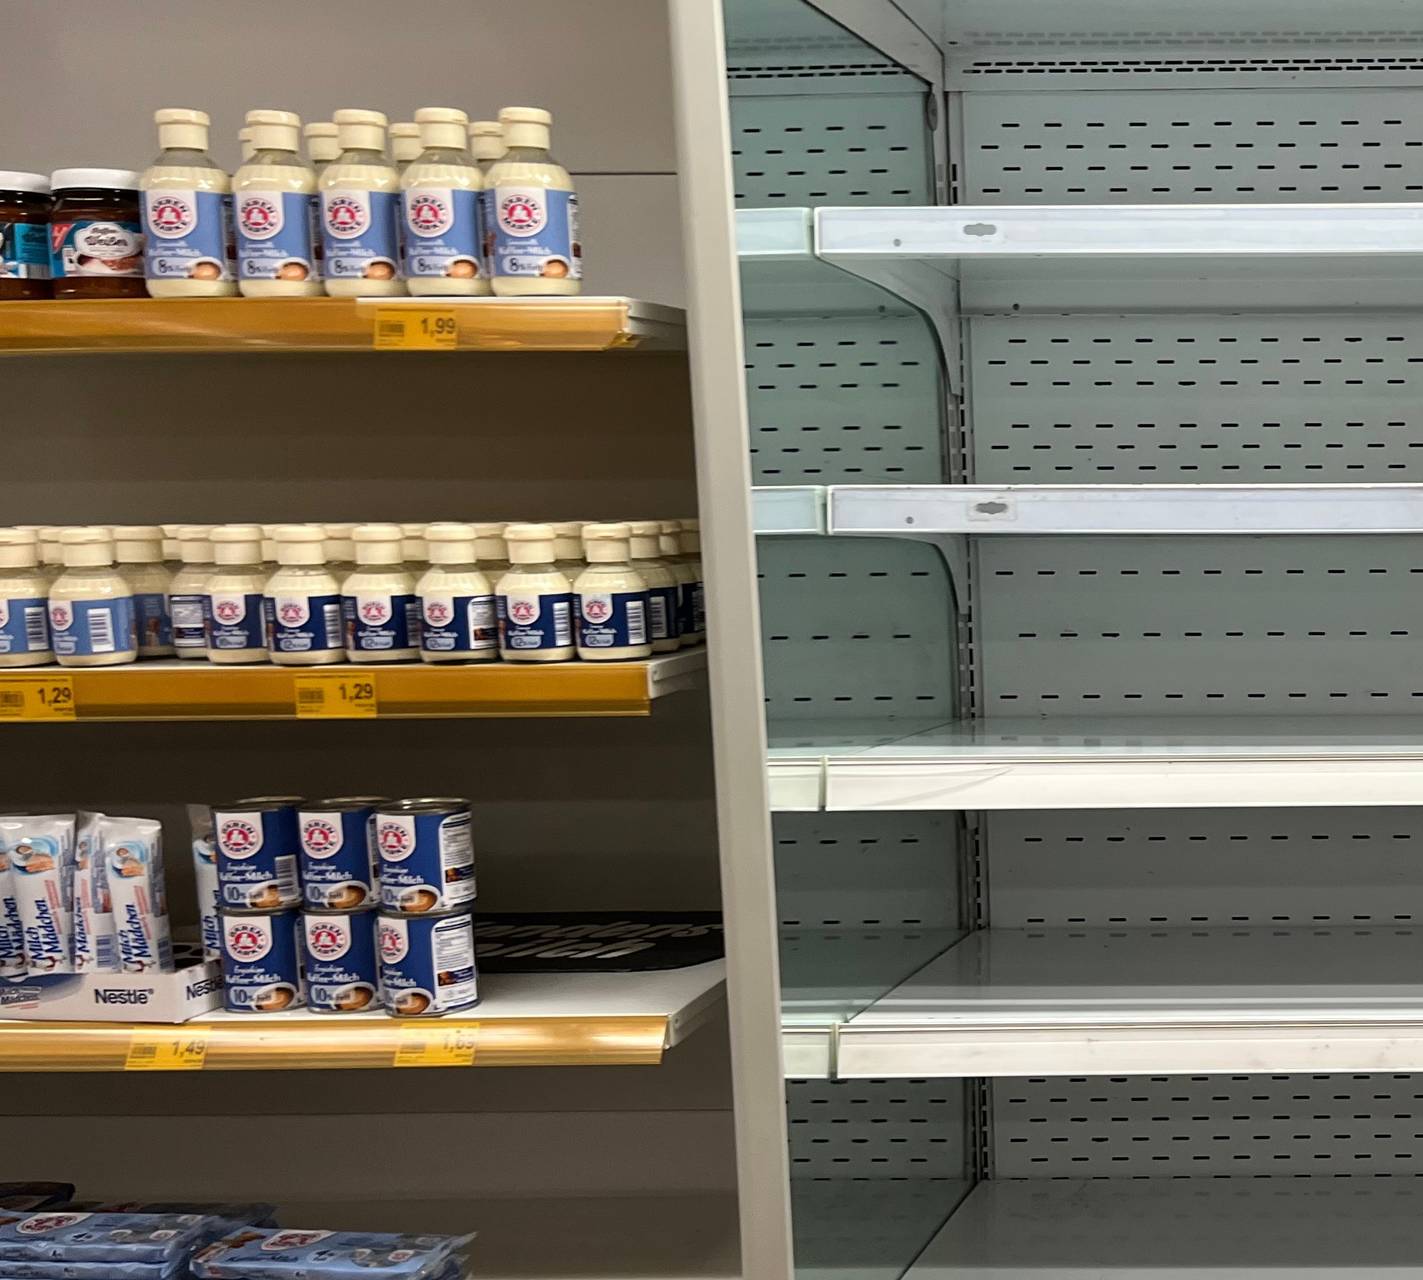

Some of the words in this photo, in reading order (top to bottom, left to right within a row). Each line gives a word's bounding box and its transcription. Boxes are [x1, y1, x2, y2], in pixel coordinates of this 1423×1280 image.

[421, 318, 456, 338] 1,99
[37, 687, 73, 706] 1,29
[339, 683, 374, 702] 1,29
[35, 898, 63, 954] Mädchen
[126, 904, 152, 958] Mädchen
[26, 926, 45, 960] Milch
[172, 1039, 206, 1058] 1,49
